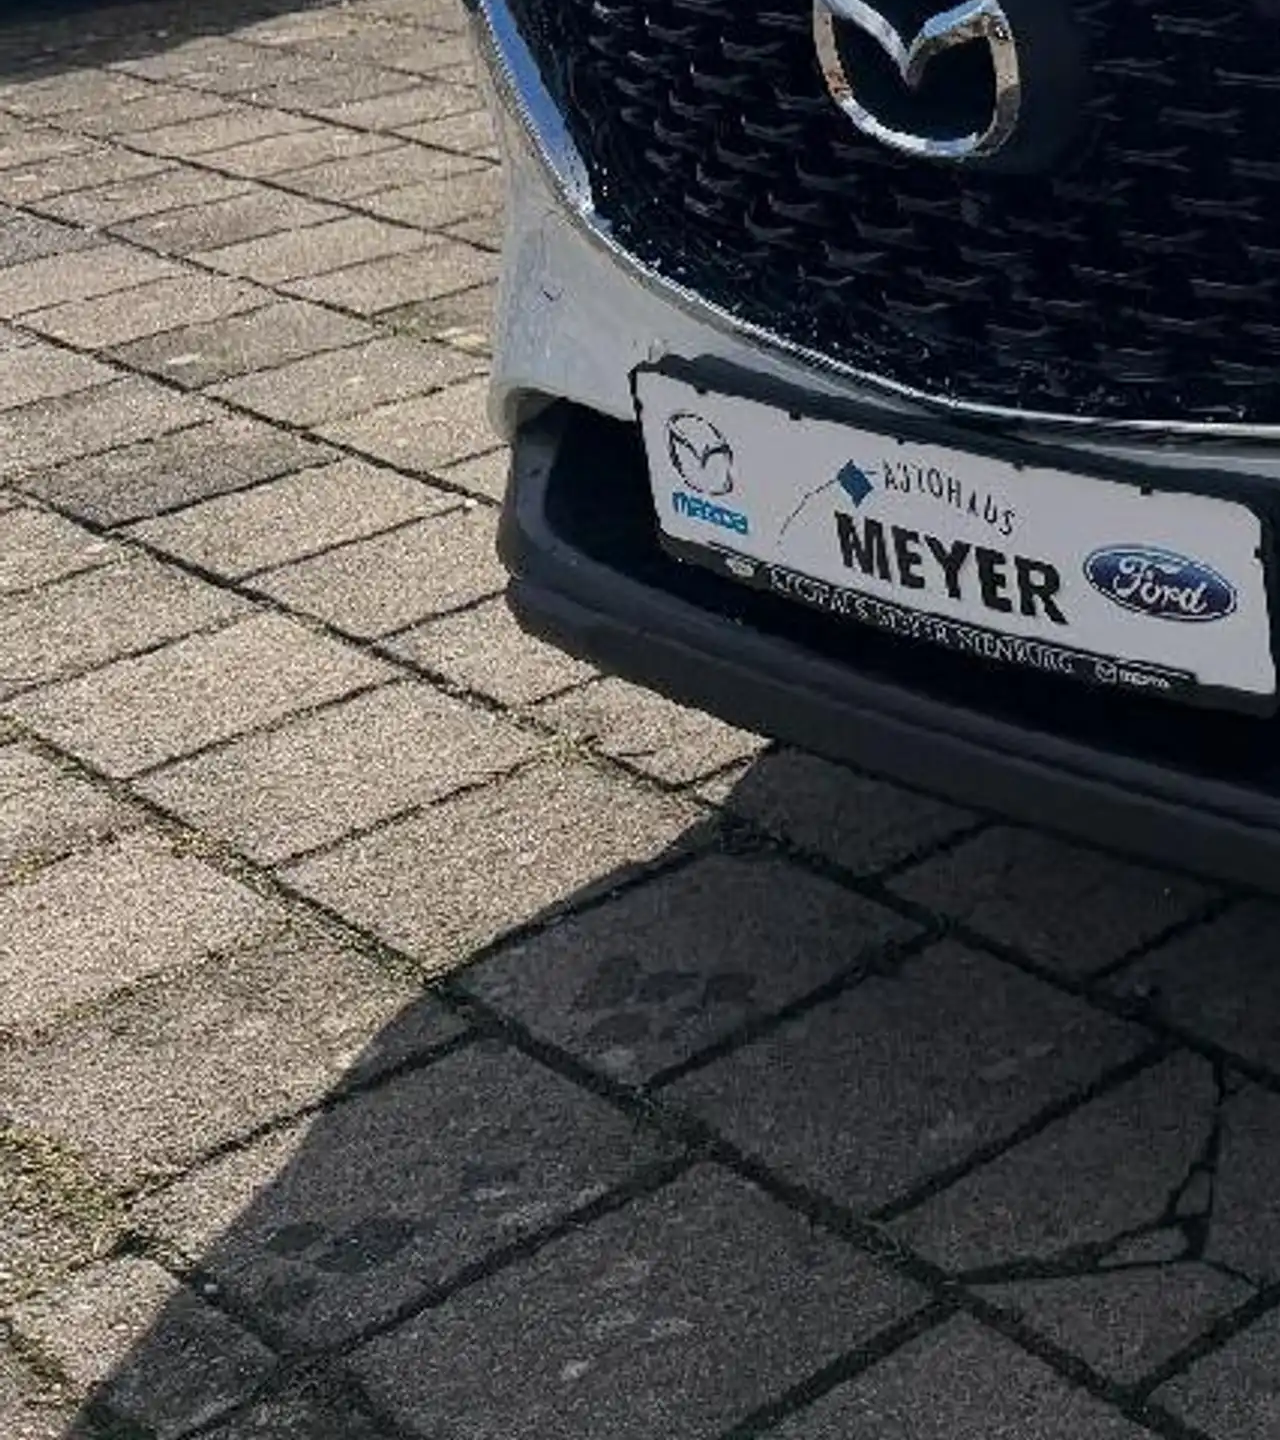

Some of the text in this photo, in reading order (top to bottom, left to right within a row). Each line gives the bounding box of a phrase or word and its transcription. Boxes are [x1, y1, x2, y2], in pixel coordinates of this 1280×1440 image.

[672, 491, 748, 535] mazda
[834, 509, 1069, 626] MEYER
[1112, 556, 1208, 613] Ford
